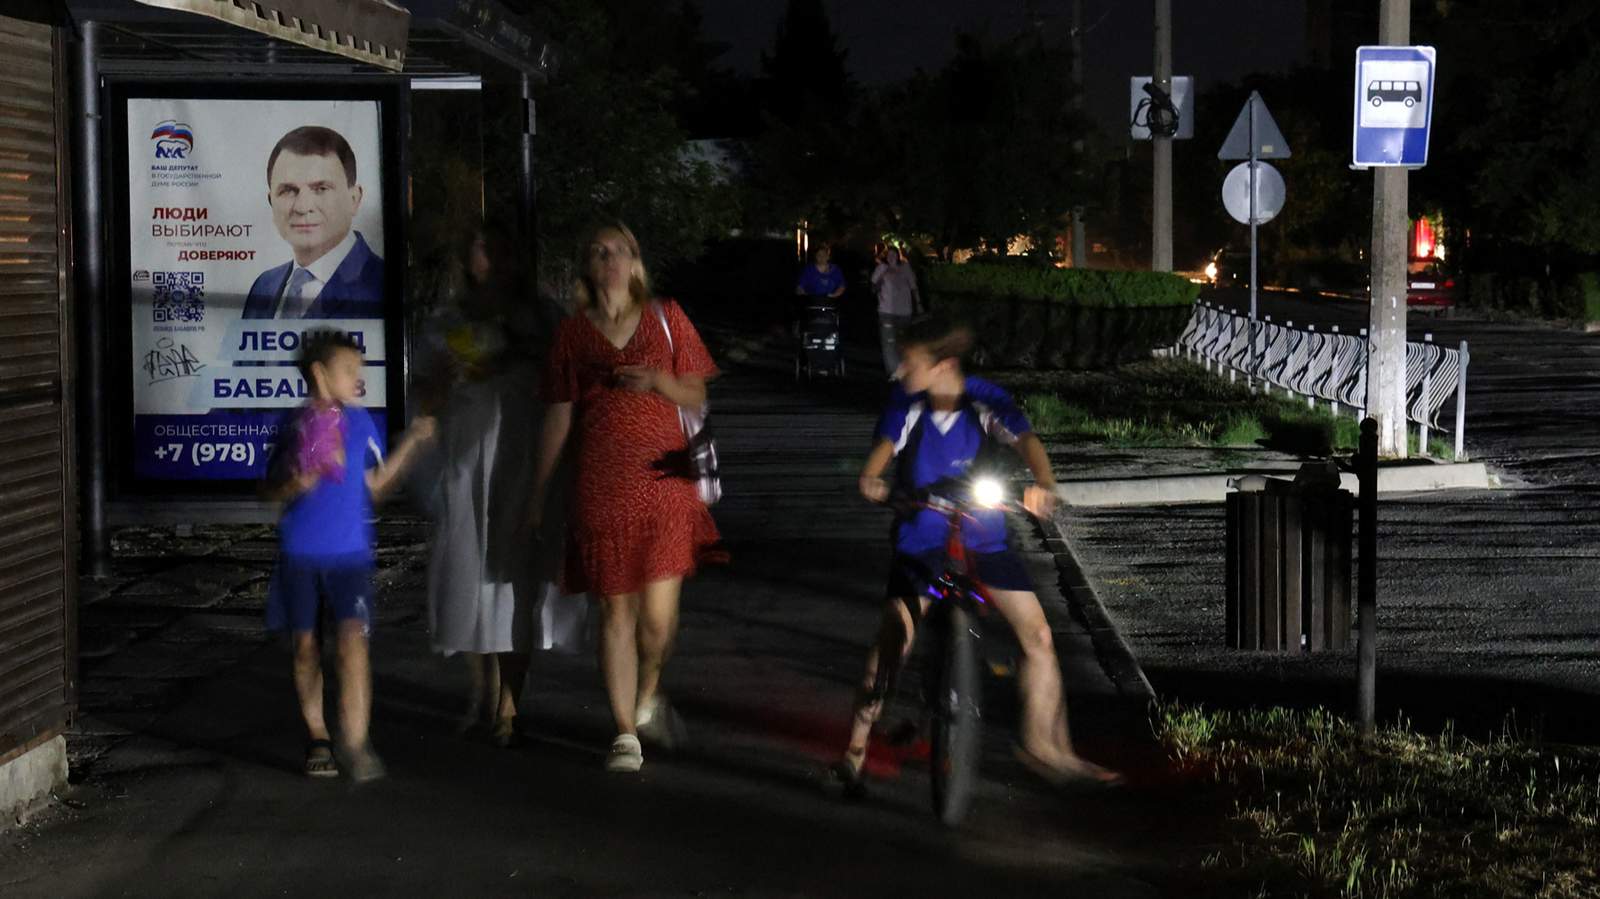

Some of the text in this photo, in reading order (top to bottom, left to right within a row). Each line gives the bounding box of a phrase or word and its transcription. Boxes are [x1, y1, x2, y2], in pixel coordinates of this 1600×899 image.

[152, 207, 208, 221] ЛЮДИ
[152, 224, 253, 237] ВЫБИРАЮТ
[178, 250, 256, 261] ДОВЕРЯЮТ
[153, 424, 279, 438] ОБЩЕСТВЕННАЯ
[153, 443, 184, 462] +7
[192, 442, 255, 466] (978)
